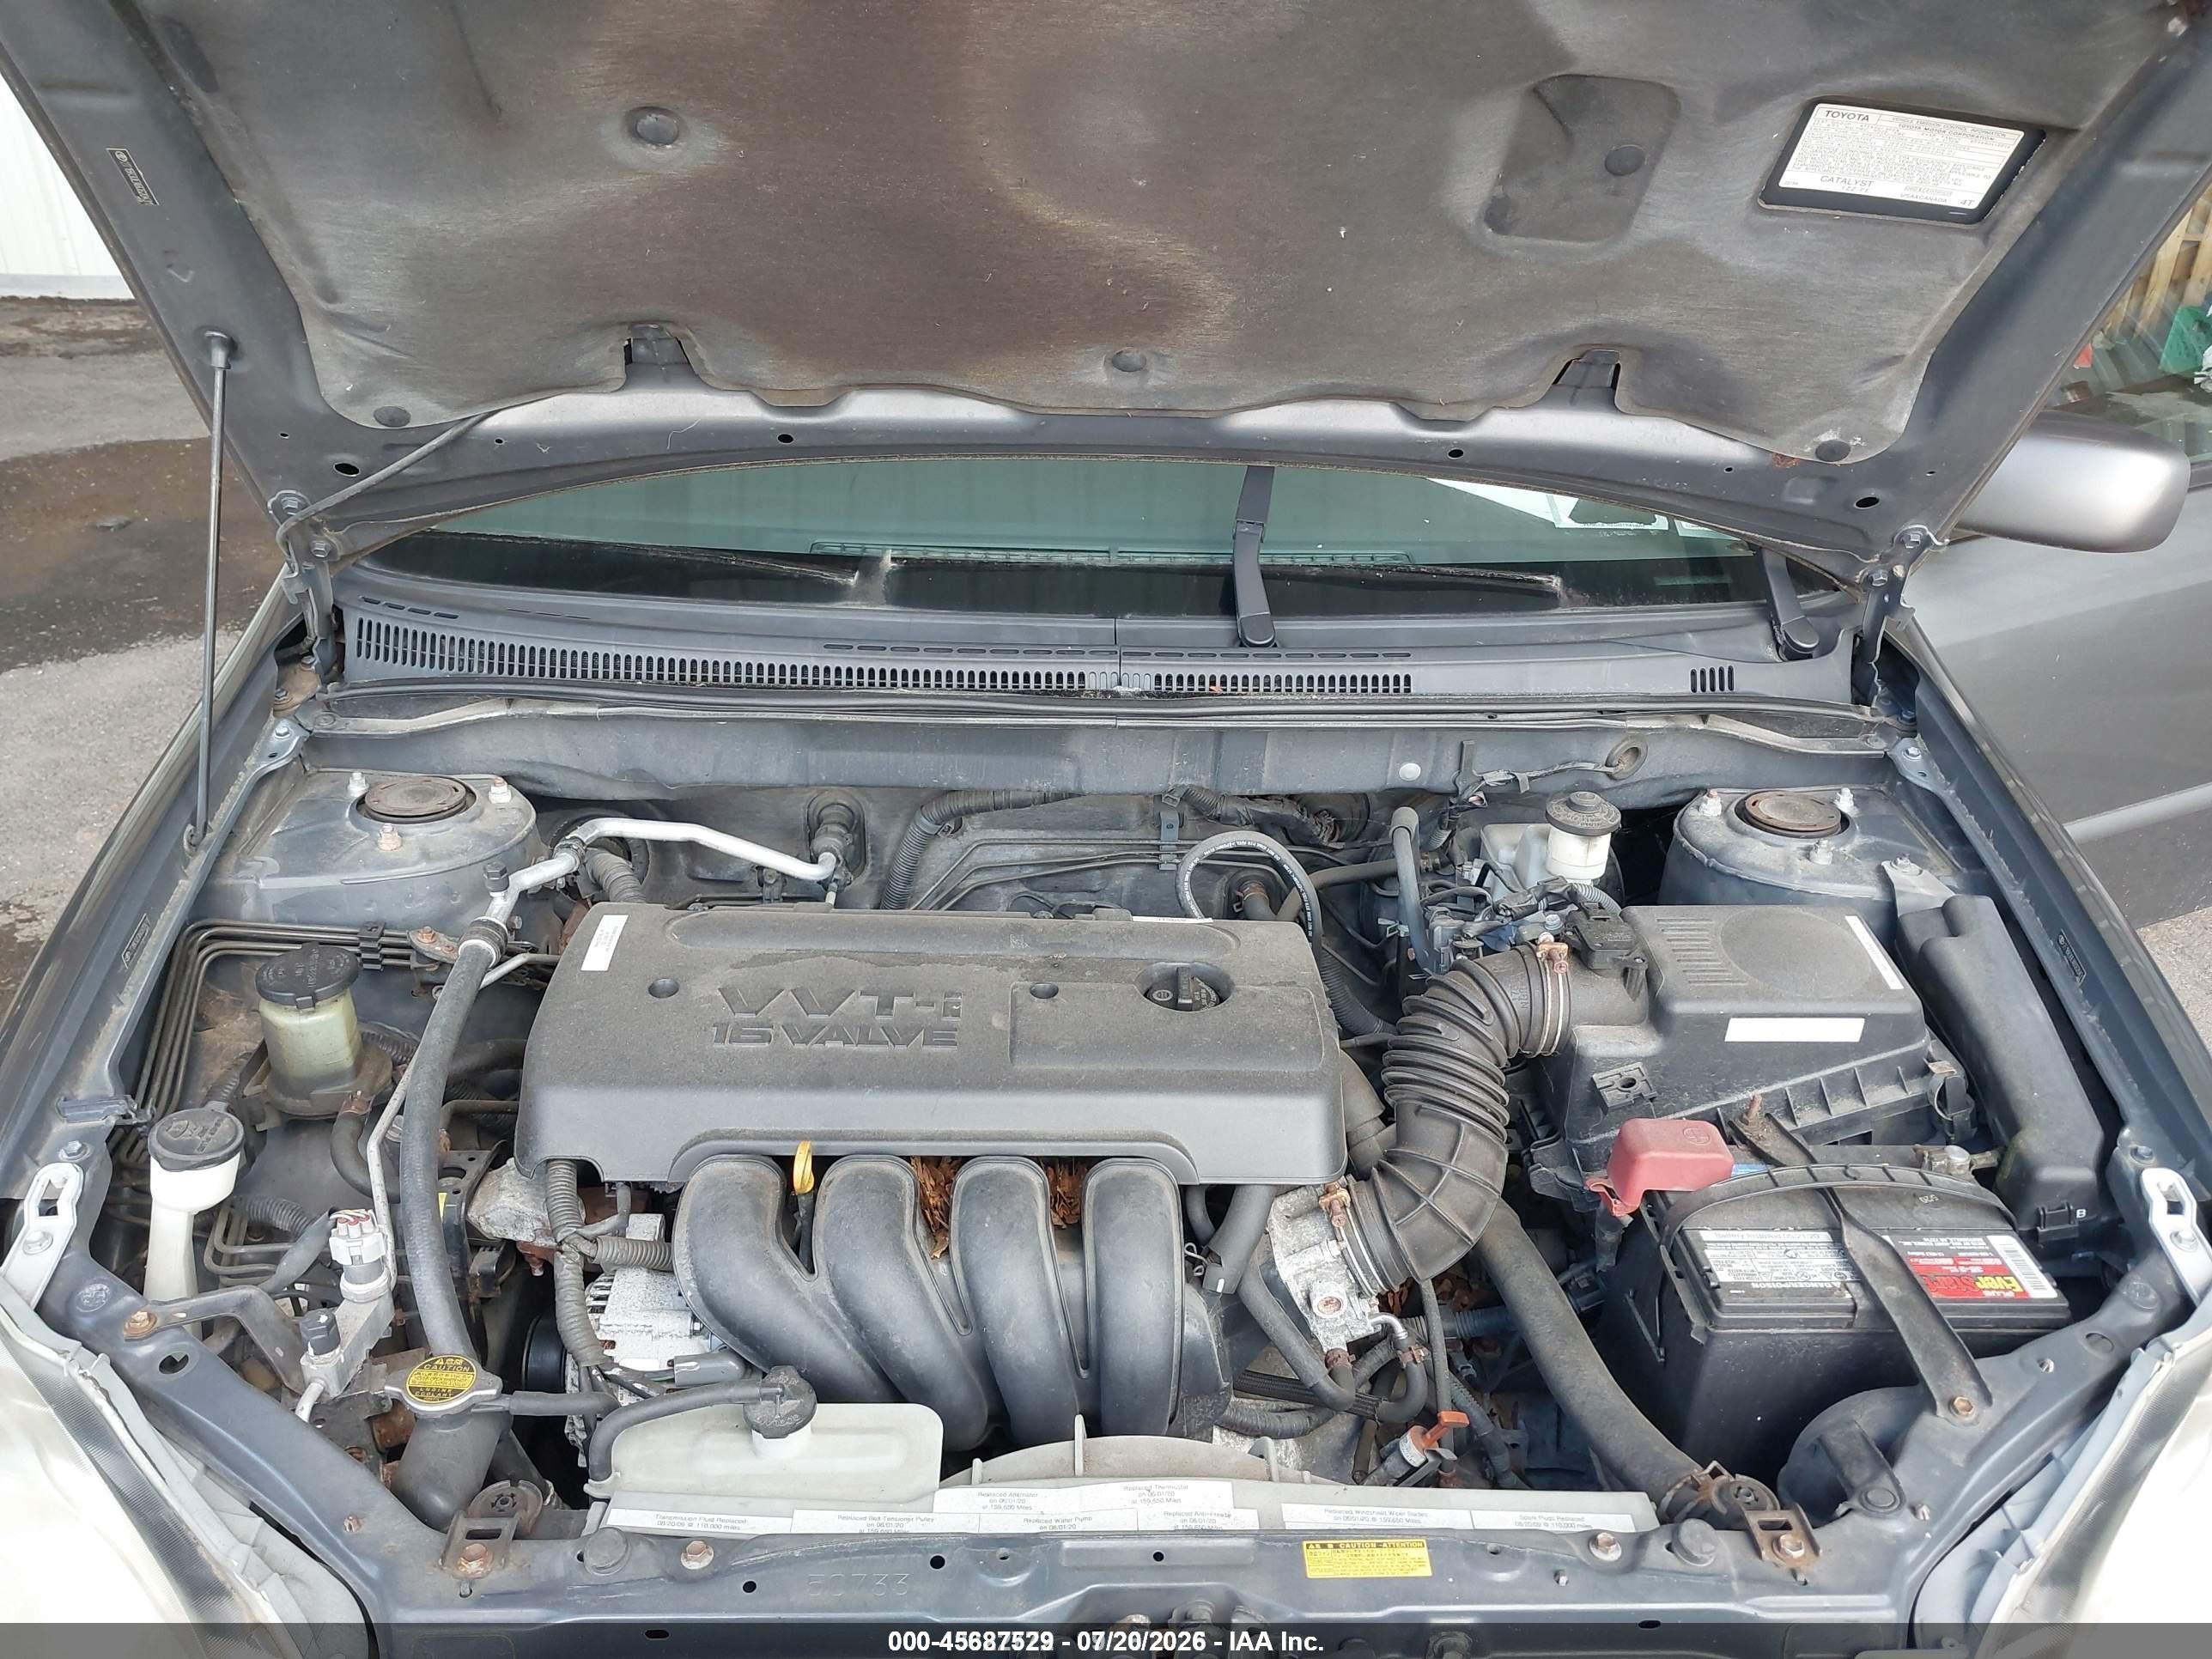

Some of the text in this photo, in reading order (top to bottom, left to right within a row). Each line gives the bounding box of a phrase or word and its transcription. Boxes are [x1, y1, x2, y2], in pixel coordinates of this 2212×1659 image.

[1826, 110, 1869, 122] TOYOTA
[1948, 131, 1995, 141] CORPORATION
[1820, 175, 1875, 187] CATALYST
[780, 1025, 958, 1050] VALVE
[2076, 1208, 2087, 1218] B
[423, 1364, 470, 1372] CAUTION
[655, 1513, 697, 1522] Transmission
